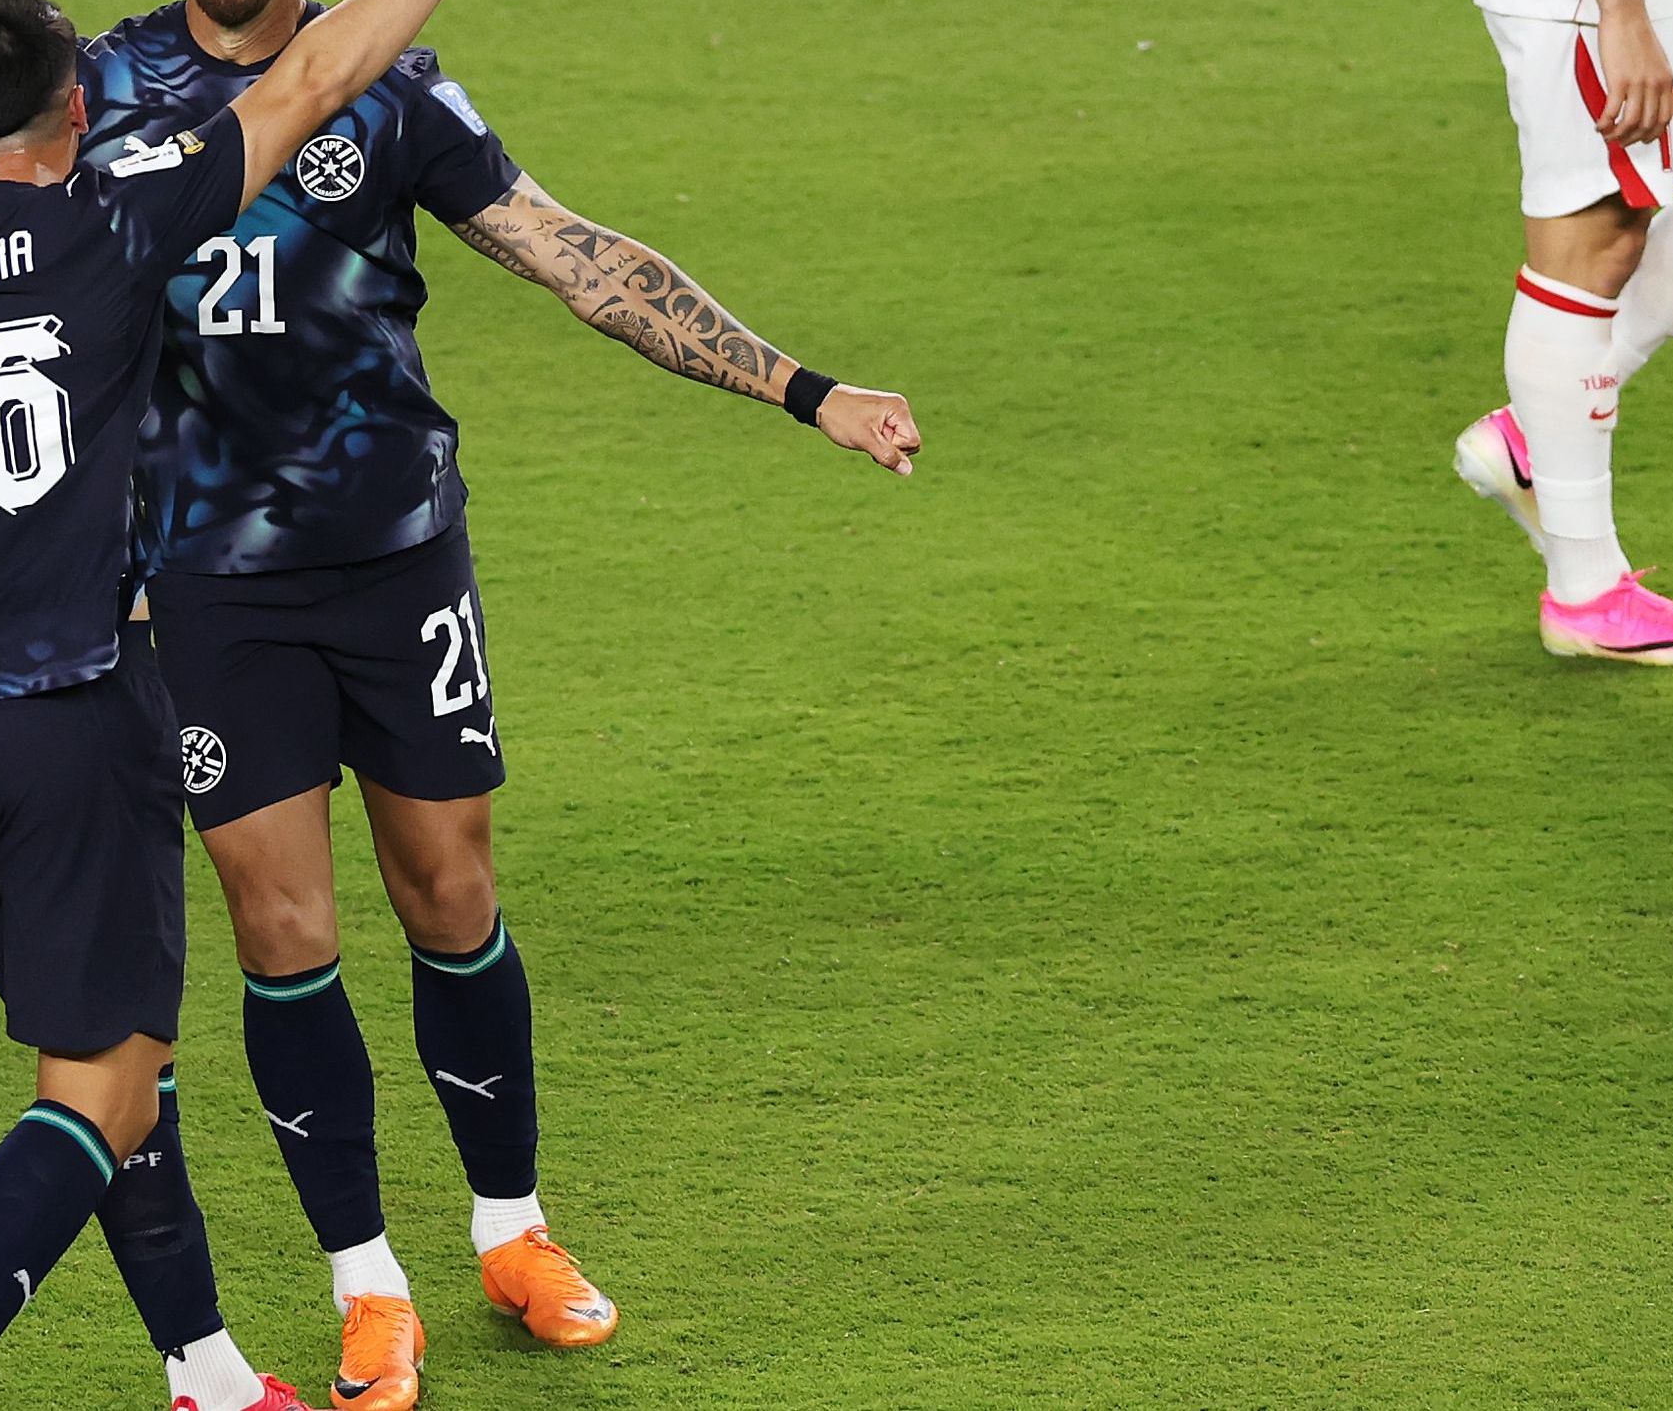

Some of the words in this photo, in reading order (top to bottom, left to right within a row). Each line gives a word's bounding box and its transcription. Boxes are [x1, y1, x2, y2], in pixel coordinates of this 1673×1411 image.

[320, 140, 343, 152] APF
[197, 235, 286, 336] 21
[420, 590, 488, 697] 21
[123, 1151, 163, 1170] PF
